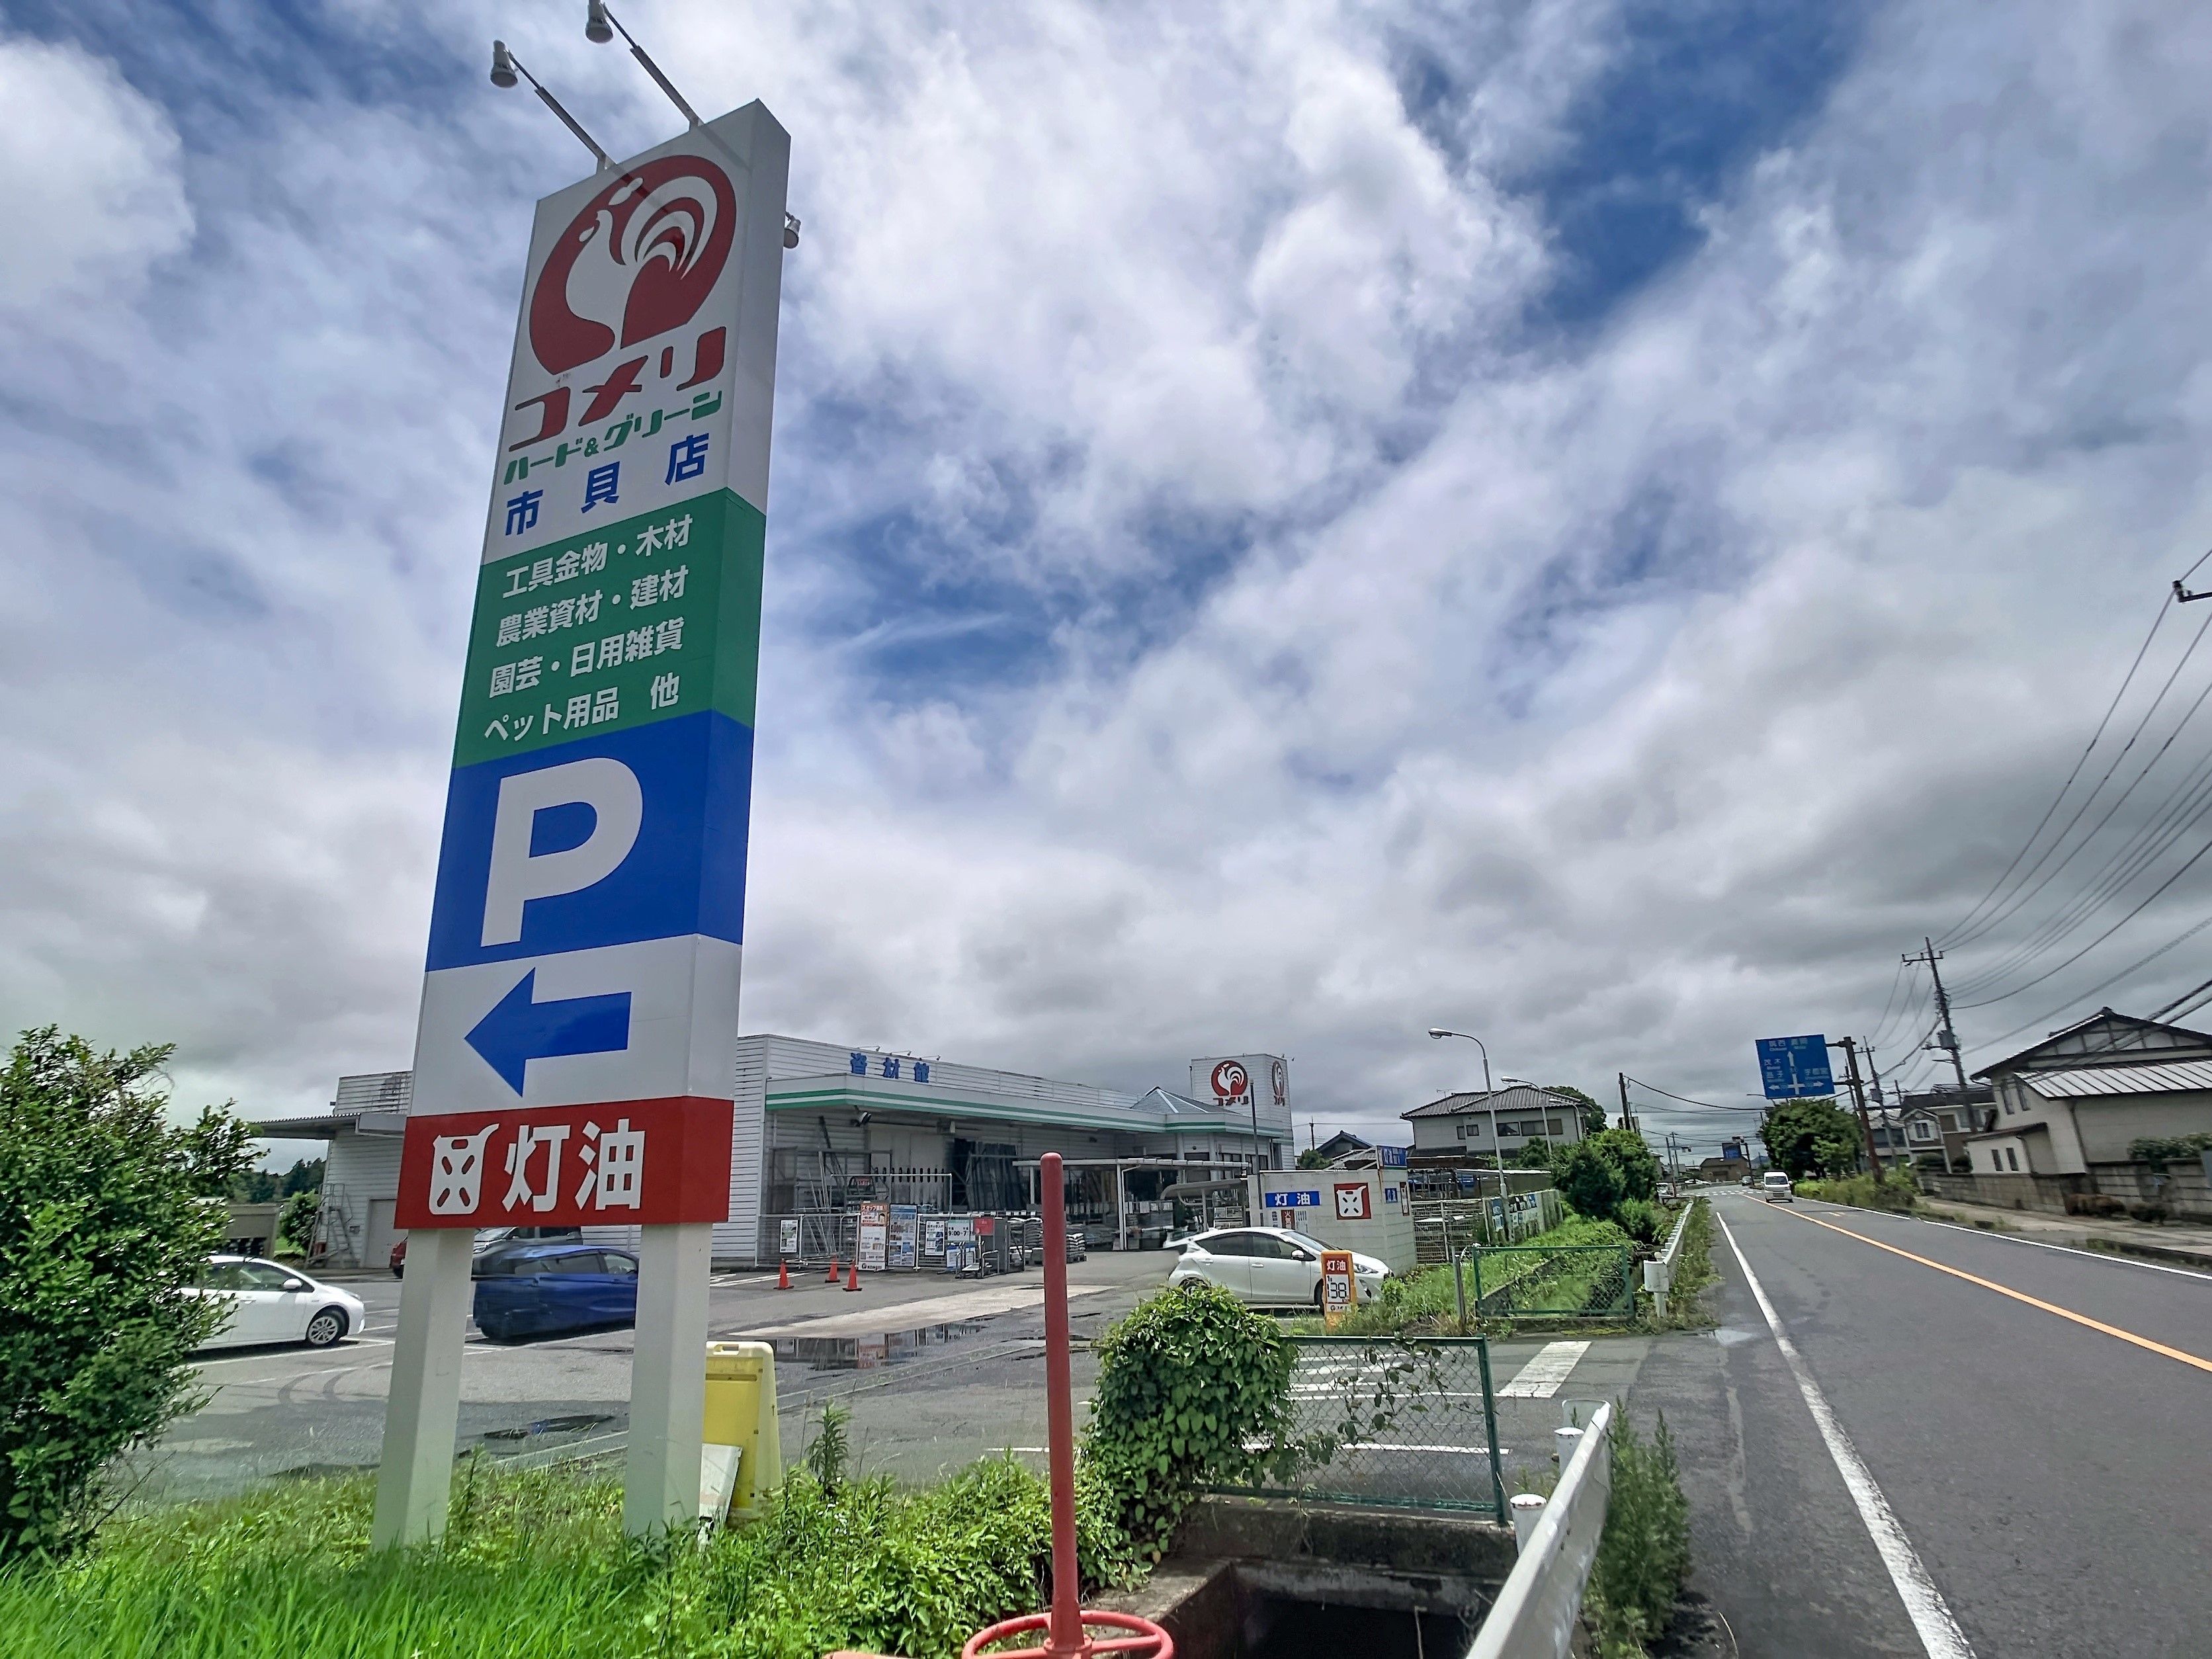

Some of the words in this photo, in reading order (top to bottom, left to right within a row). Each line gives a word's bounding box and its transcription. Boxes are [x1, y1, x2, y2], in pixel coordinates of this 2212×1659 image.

[508, 326, 727, 452] コメリ
[503, 390, 722, 486] ハード&グリーン
[502, 513, 693, 599] 工具金物・木材
[495, 565, 689, 648] 農業資材・建材
[488, 616, 685, 699] 園芸・日用雑貨
[484, 686, 619, 742] ペット用品
[650, 671, 681, 711] 他
[480, 757, 644, 947] P
[1213, 1096, 1249, 1106] コメリ
[501, 1118, 646, 1212] 灯油
[1275, 1192, 1311, 1206] 灯油
[1327, 1259, 1347, 1271] 灯油
[1327, 1282, 1347, 1299] 138
